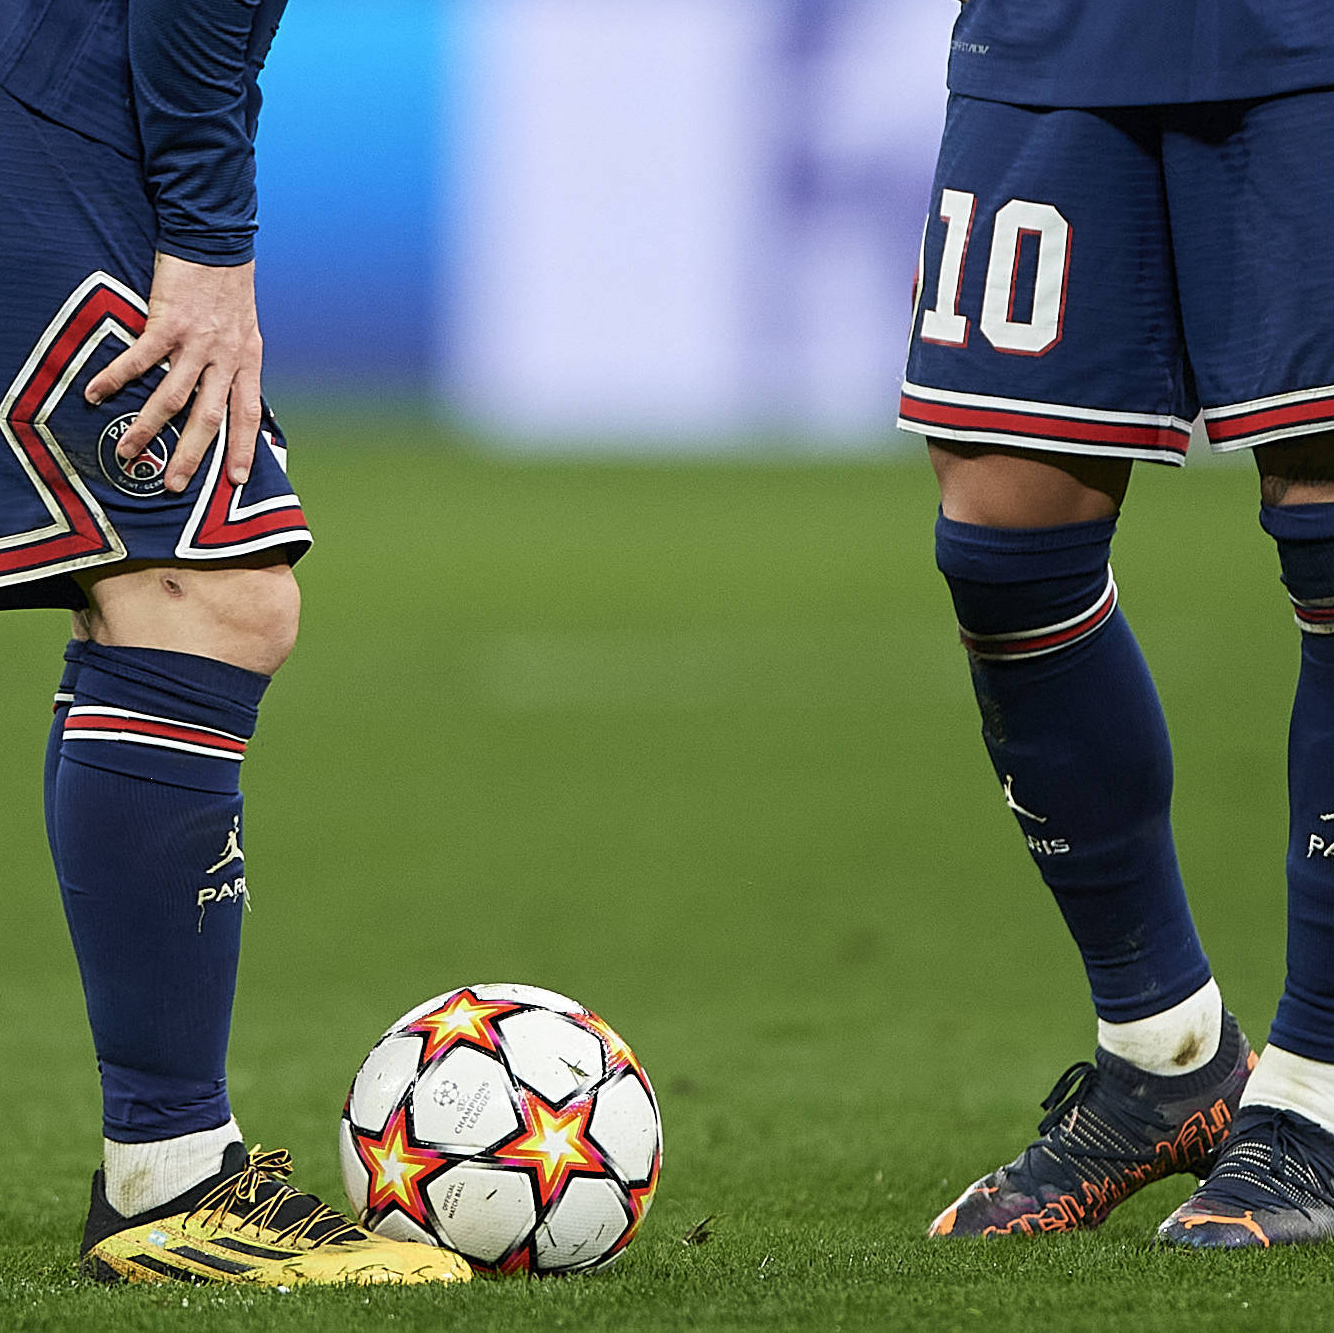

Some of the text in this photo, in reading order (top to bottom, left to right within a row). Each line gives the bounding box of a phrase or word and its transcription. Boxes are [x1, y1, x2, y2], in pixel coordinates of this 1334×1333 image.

[920, 188, 1073, 357] 10
[454, 1081, 490, 1134] CHAMPIONS
[448, 1181, 465, 1219] MATCH BALL
